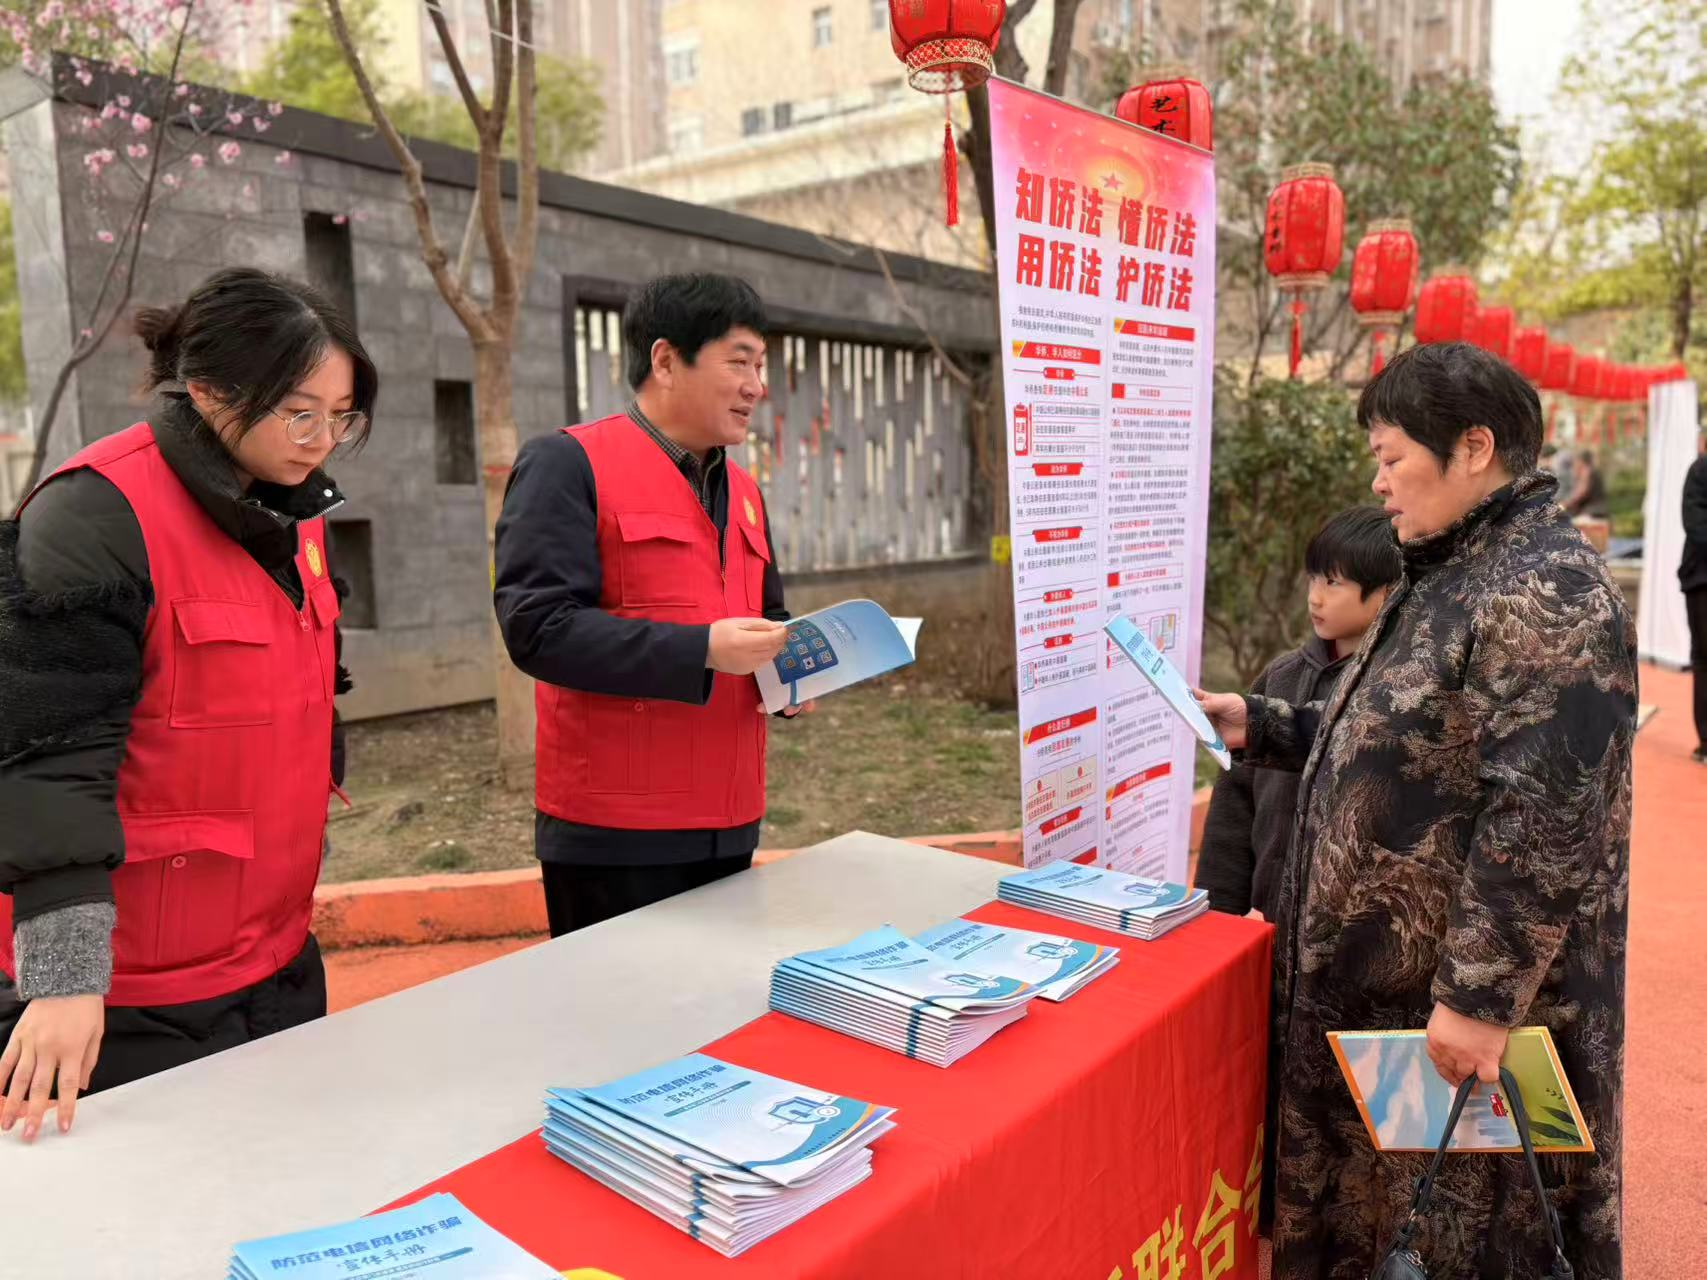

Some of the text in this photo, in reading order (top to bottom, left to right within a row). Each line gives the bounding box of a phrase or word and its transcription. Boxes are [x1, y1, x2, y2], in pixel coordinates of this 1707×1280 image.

[1015, 167, 1104, 238] 知侨法
[1118, 196, 1197, 257] 懂侨法
[1016, 233, 1194, 312] 用侨法 护侨法
[271, 1215, 463, 1271] 防范电信网络诈骗
